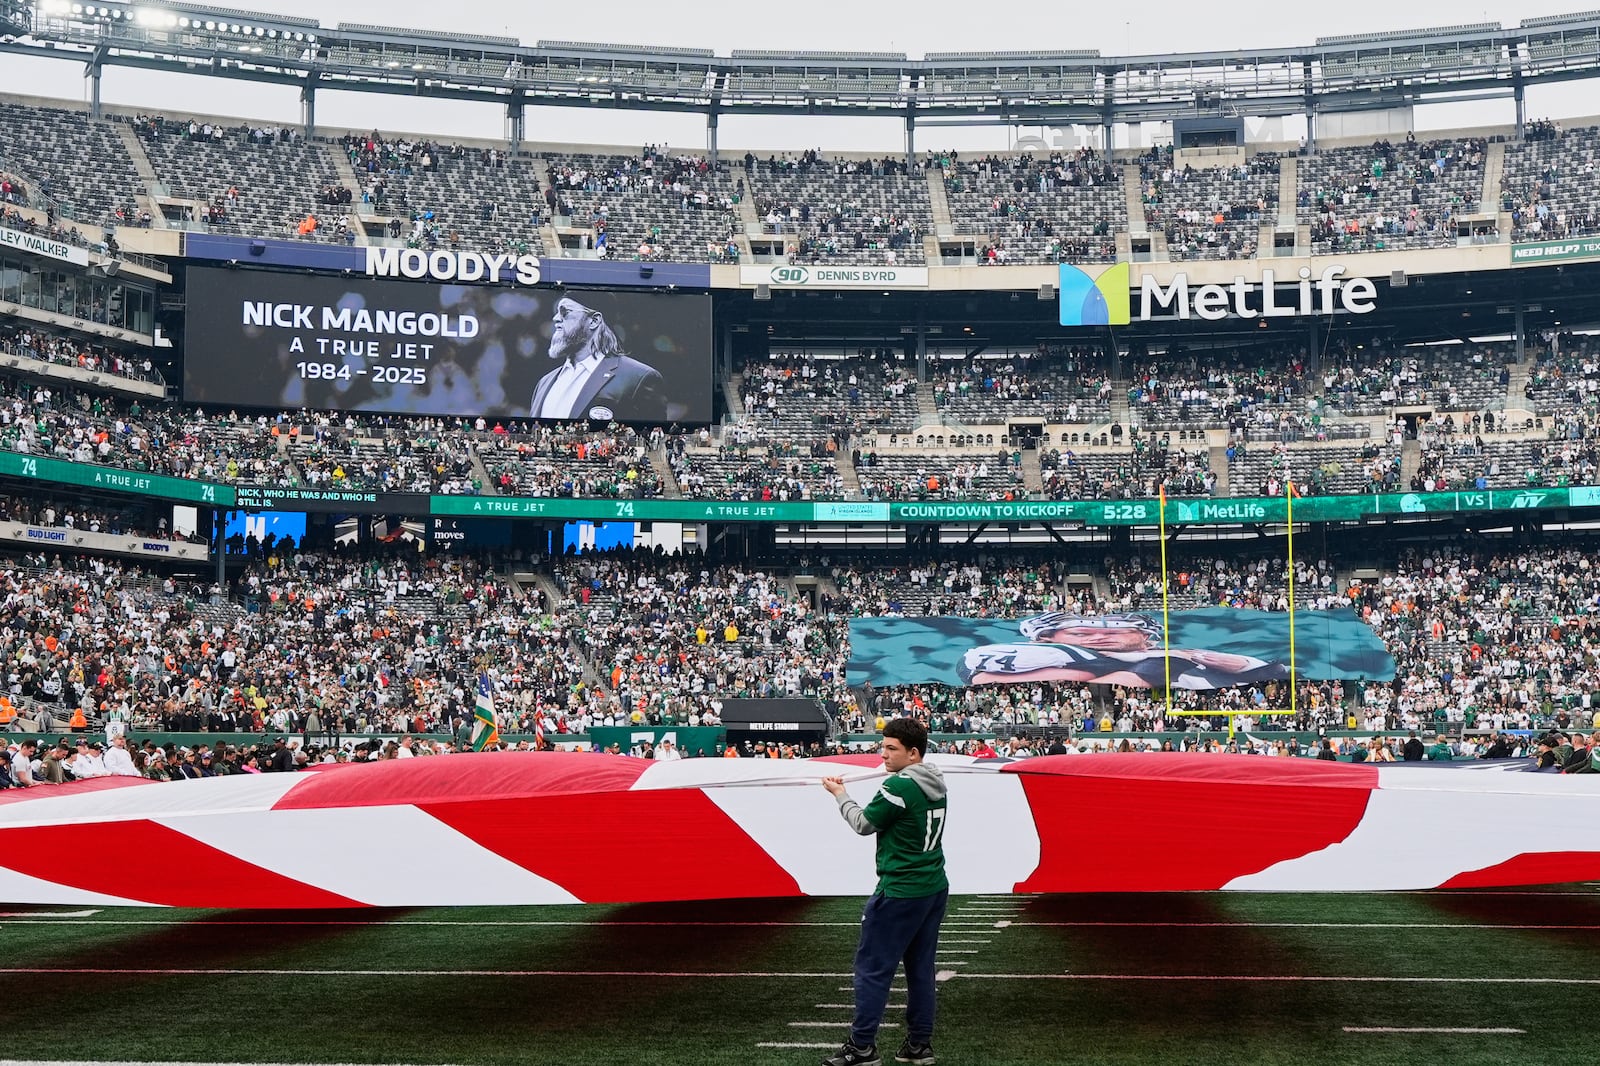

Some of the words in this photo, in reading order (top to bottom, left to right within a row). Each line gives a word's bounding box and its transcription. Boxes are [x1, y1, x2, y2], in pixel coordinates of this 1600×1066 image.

[24, 236, 68, 258] WALKER
[1514, 247, 1544, 258] NEED
[1544, 244, 1580, 256] HELP?
[365, 247, 541, 285] MOODY'S
[778, 269, 802, 281] 90
[817, 271, 860, 281] DENNIS
[862, 271, 897, 281] BYRD
[1140, 264, 1378, 321] MetLife
[243, 300, 314, 329] NICK
[322, 306, 479, 338] MANGOLD
[289, 337, 304, 353] A
[316, 338, 380, 357] TRUE
[391, 343, 434, 360] JET
[297, 362, 351, 381] 1984
[372, 366, 426, 385] 2025
[22, 457, 37, 476] 74
[95, 473, 102, 482] A
[105, 474, 130, 486] TRUE
[134, 478, 151, 489] JET
[201, 485, 215, 501] 74
[237, 489, 261, 498] NICK,
[263, 489, 284, 498] WHO
[286, 490, 299, 498] HE
[300, 490, 320, 499] WAS
[321, 491, 340, 500] AND
[341, 493, 362, 501] WHO
[364, 493, 377, 502] HE
[237, 498, 262, 507] STILL
[263, 499, 274, 507] IS.
[1465, 494, 1484, 506] VS
[474, 502, 481, 510] A
[487, 502, 518, 511] TRUE
[523, 503, 545, 512] JET
[616, 502, 634, 516] 74
[705, 506, 713, 515] A
[718, 506, 749, 516] TRUE
[754, 507, 775, 516] JET
[900, 505, 991, 517] COUNTDOWN
[994, 505, 1012, 516] TO
[1016, 505, 1074, 516] KICKOFF
[1104, 505, 1147, 520] 5:28
[1204, 503, 1265, 519] MetLife
[28, 529, 45, 538] BUD
[44, 531, 65, 541] LIGHT
[434, 530, 465, 540] moves
[975, 654, 1017, 672] 74
[749, 722, 774, 731] METLIFE
[774, 722, 800, 731] STADIUM
[923, 807, 946, 853] 17
